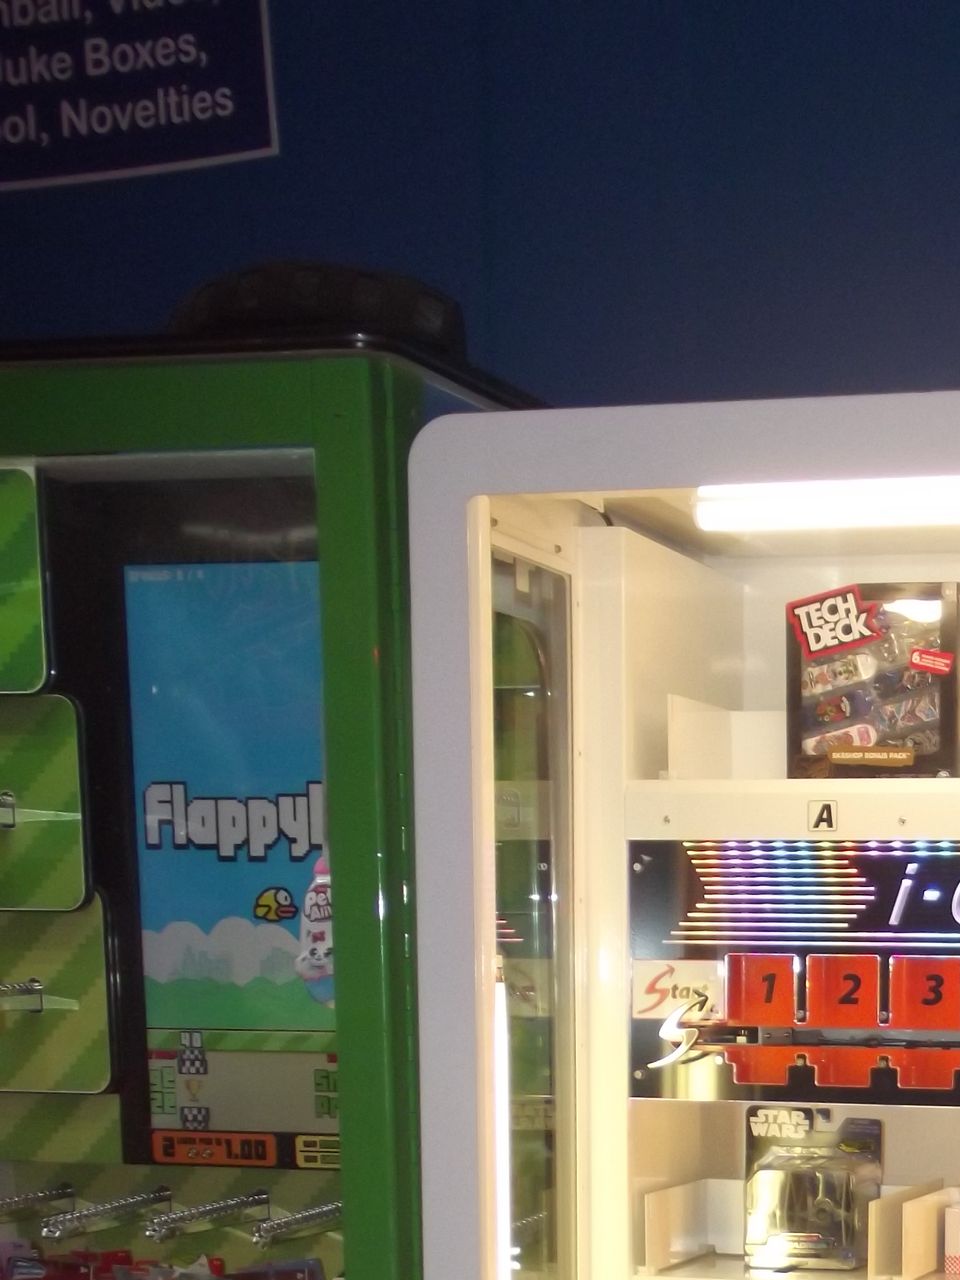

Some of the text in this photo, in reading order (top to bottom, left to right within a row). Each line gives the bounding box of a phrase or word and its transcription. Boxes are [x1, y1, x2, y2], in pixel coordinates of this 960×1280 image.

[0, 33, 208, 86] uke Boxes,
[0, 84, 235, 146] ol, Novelties
[794, 593, 858, 627] TECH
[805, 613, 875, 652] DECK
[812, 803, 833, 828] A
[761, 973, 777, 1004] 1
[838, 974, 862, 1005] 2
[921, 975, 945, 1006] 3
[749, 1109, 810, 1125] STAR
[750, 1123, 810, 1138] WARS
